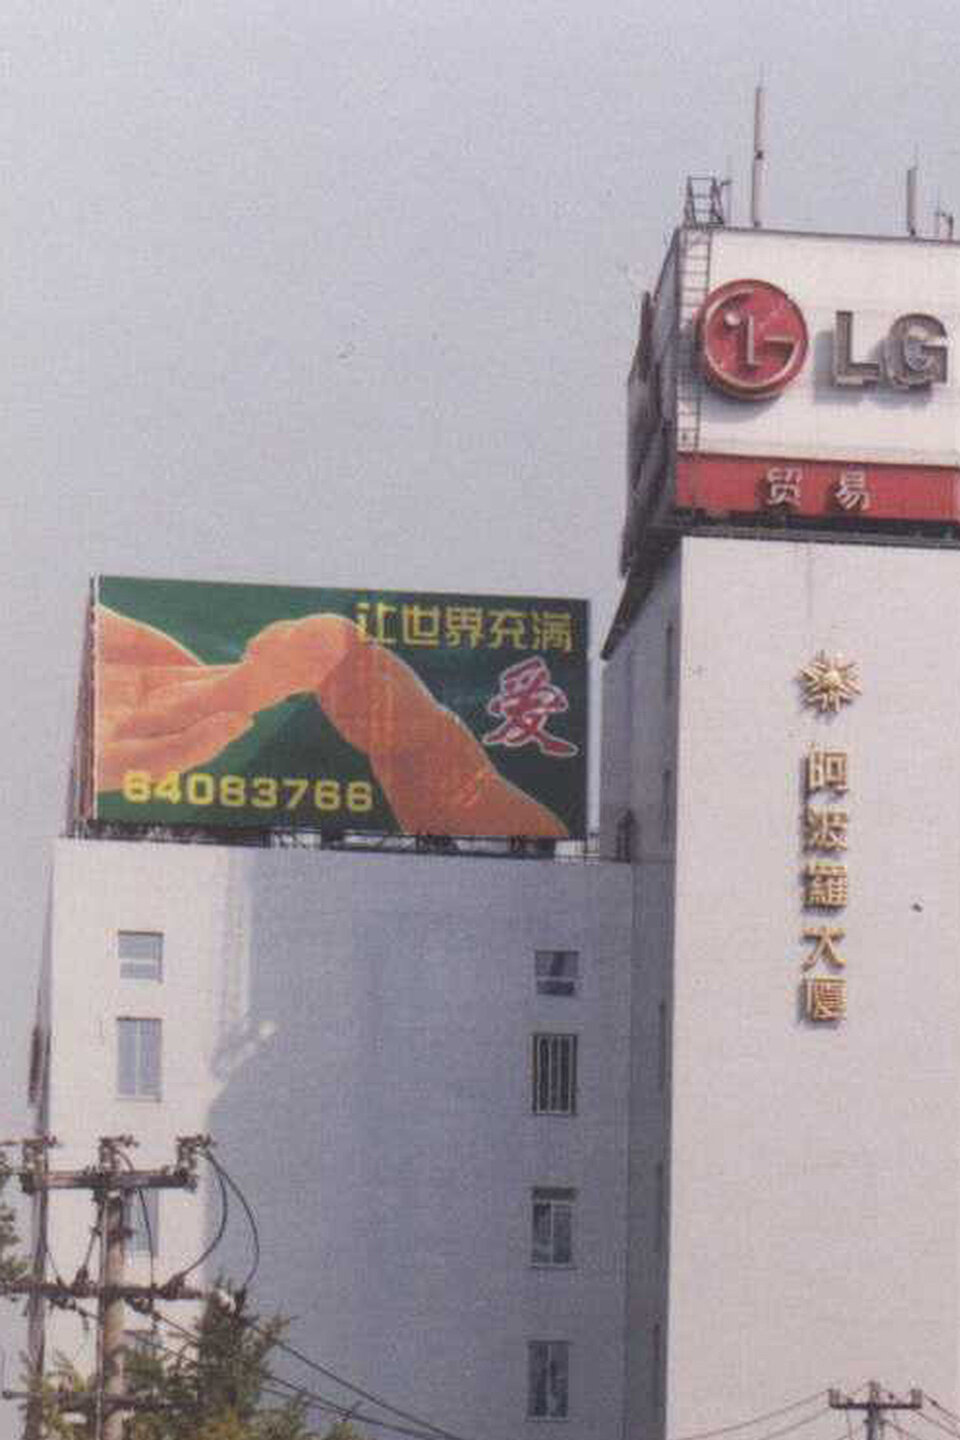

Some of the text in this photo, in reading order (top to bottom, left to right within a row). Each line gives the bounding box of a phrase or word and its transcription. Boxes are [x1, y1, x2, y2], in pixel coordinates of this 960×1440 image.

[832, 310, 949, 390] LG
[766, 468, 871, 513] 贸易
[352, 601, 574, 652] 让世界充满
